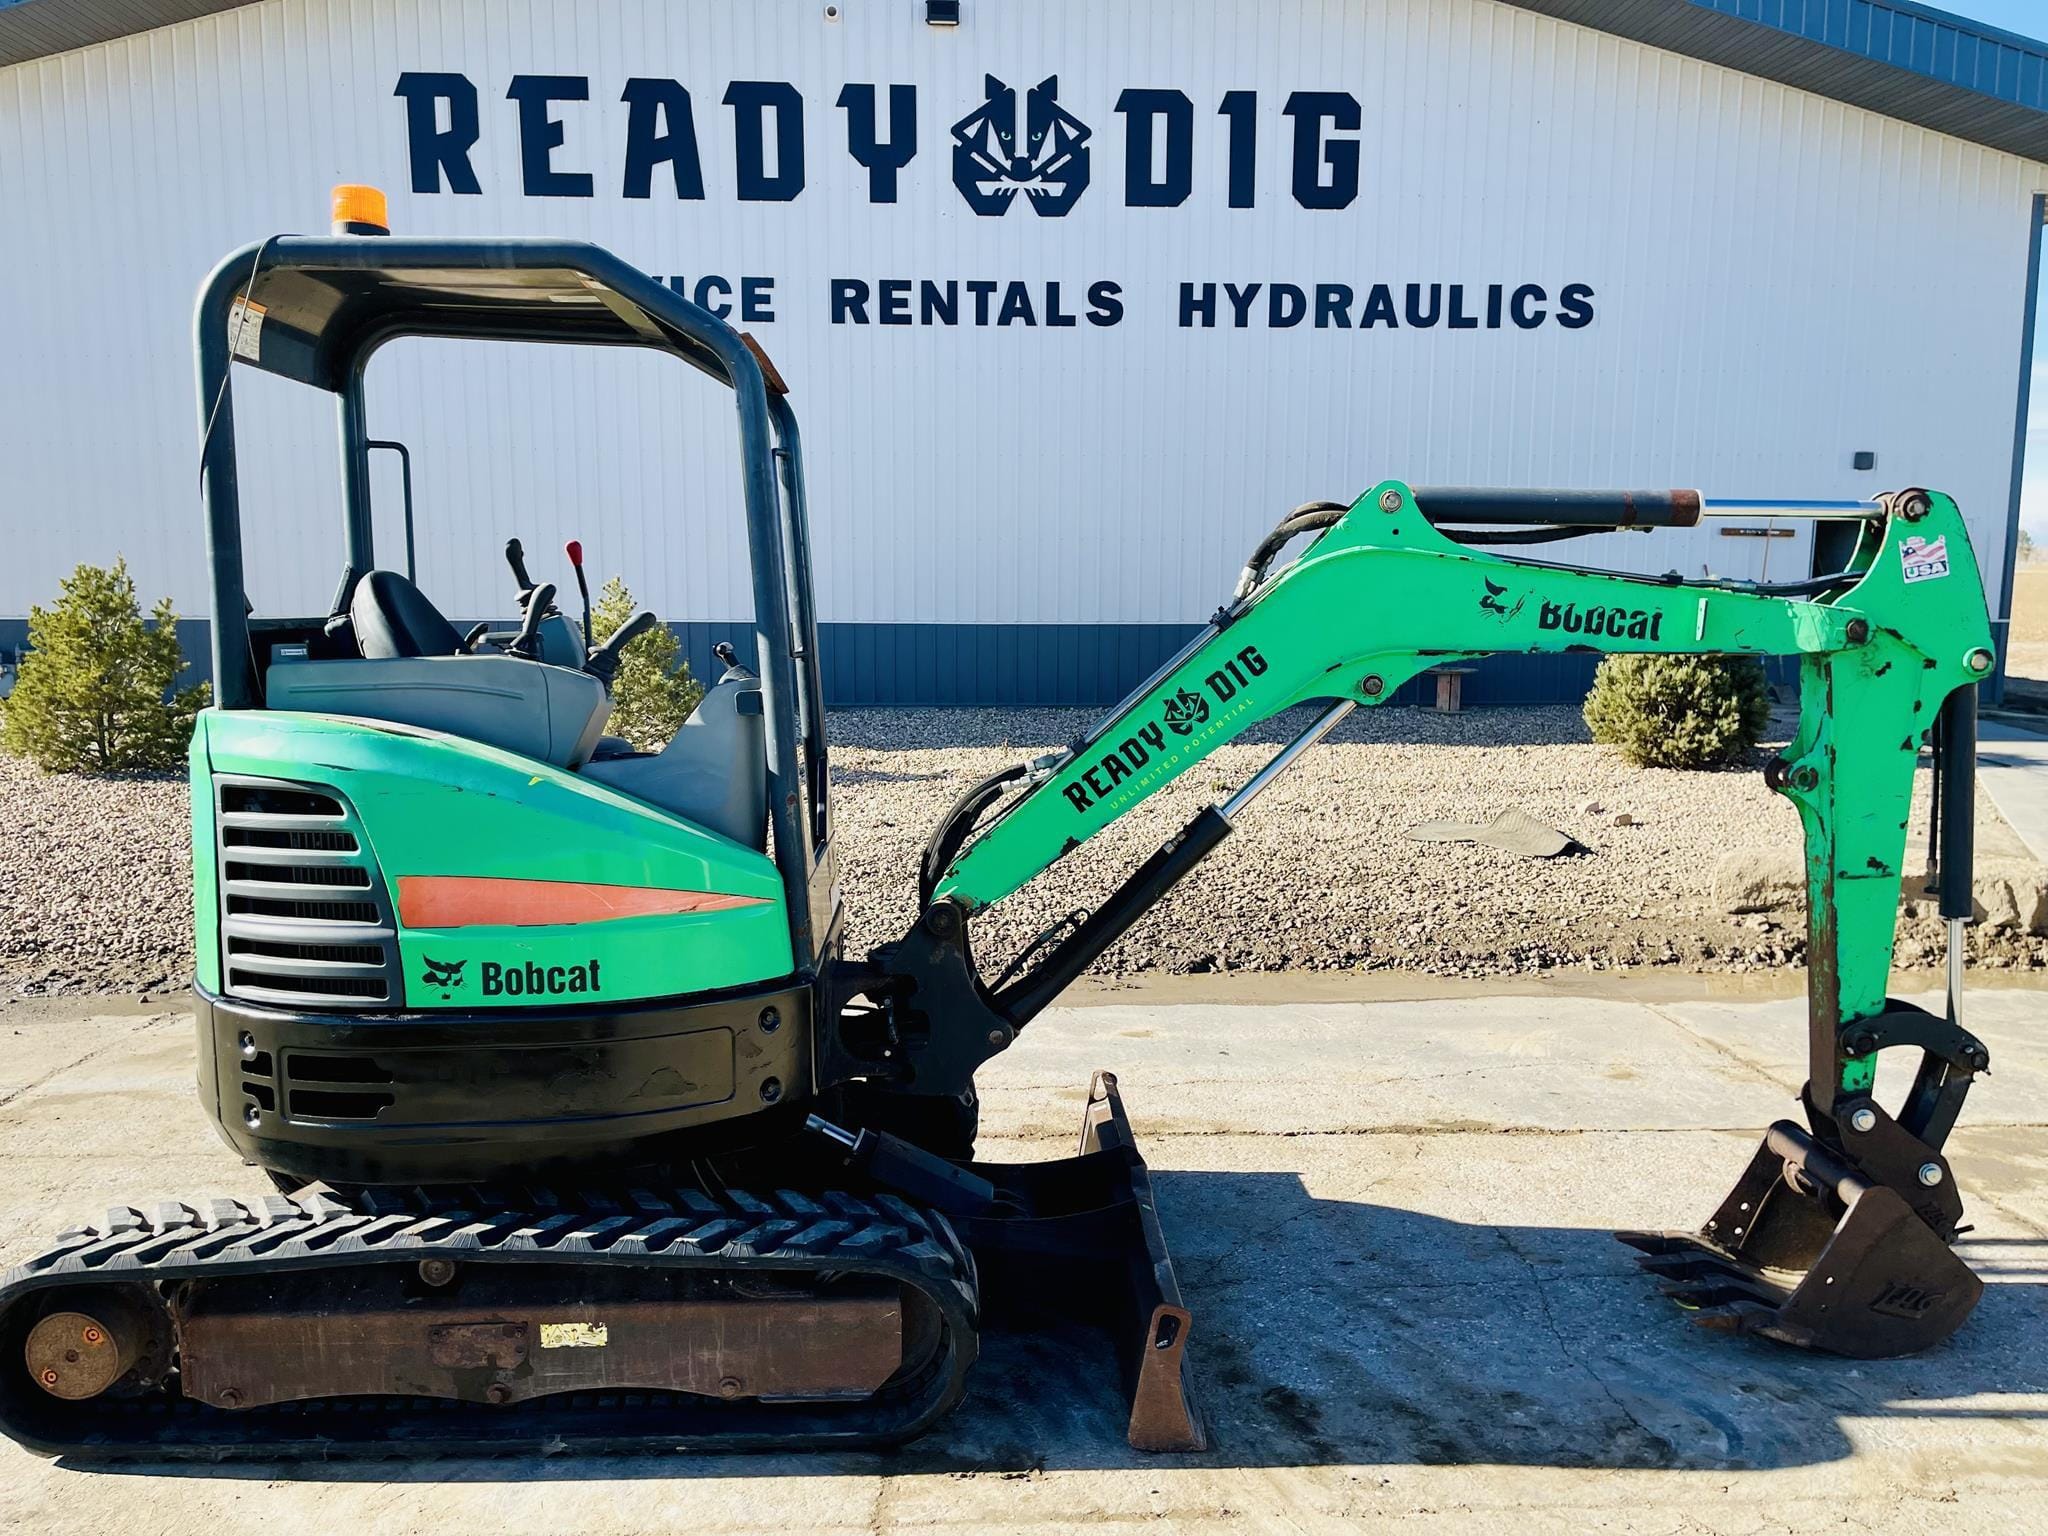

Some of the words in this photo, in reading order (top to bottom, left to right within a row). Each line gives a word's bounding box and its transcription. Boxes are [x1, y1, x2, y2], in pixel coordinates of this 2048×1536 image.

[394, 71, 918, 204] READY
[831, 278, 1124, 327] RENTALS
[1178, 282, 1595, 330] HYDRAULICS
[1905, 561, 1946, 578] USA
[1062, 721, 1166, 814] READY
[1109, 755, 1179, 810] UNLIMITED
[1183, 698, 1255, 753] POTENTIAL
[482, 959, 601, 996] Bobcat
